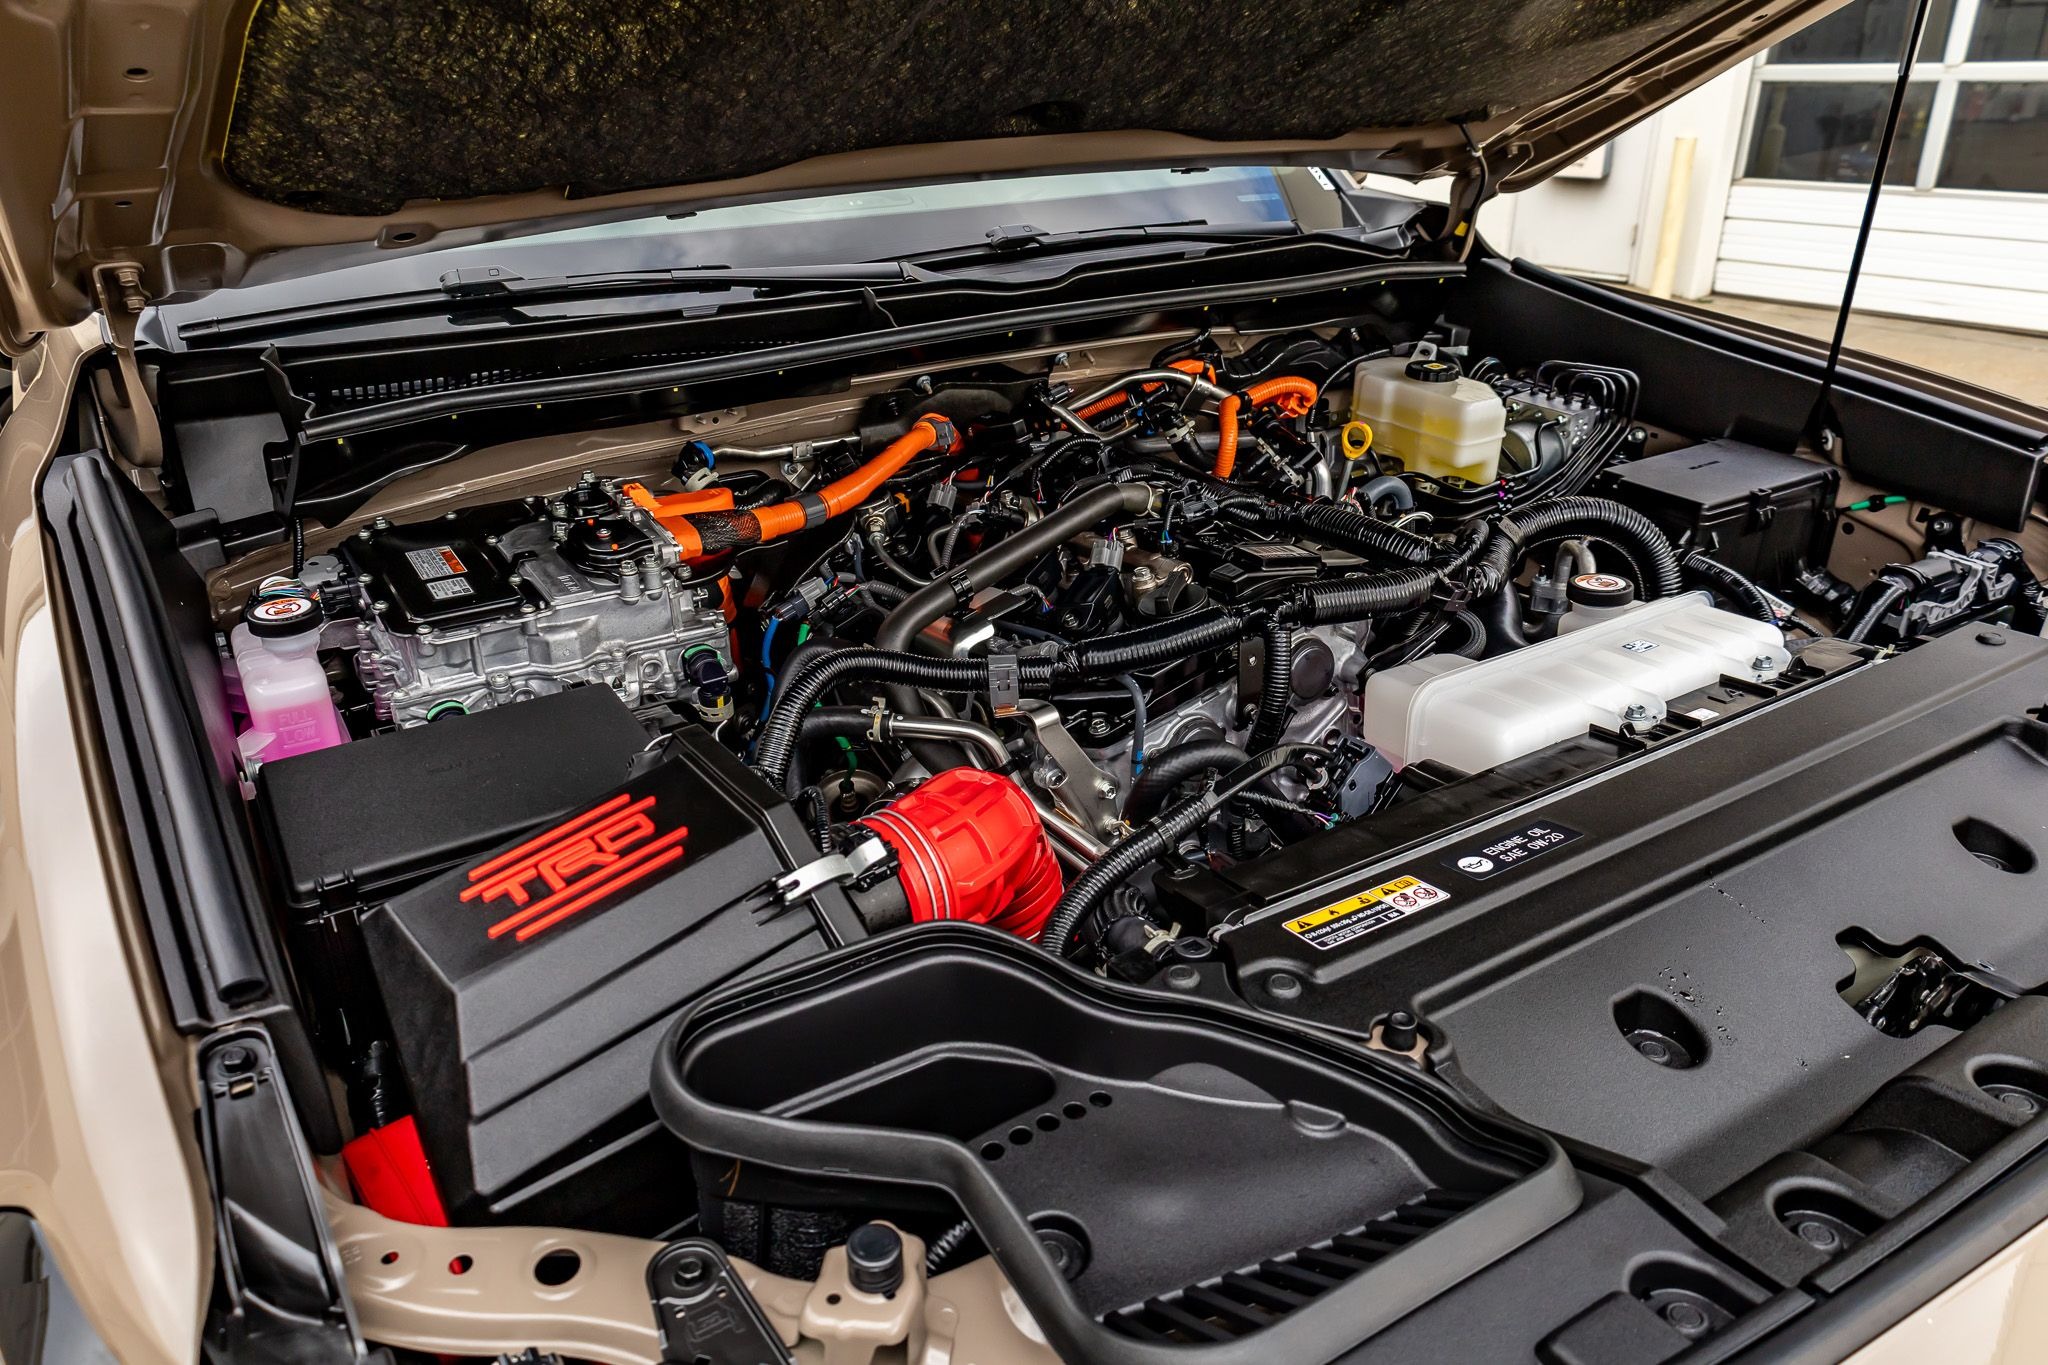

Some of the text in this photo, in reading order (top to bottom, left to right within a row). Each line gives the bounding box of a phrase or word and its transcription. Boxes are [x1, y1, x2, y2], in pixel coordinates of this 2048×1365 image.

[278, 710, 313, 724] FULL
[283, 726, 316, 743] LOW
[1482, 827, 1551, 856] ENGINE OIL
[1499, 832, 1565, 862] SAE 0W-20
[482, 813, 656, 906] TRD
